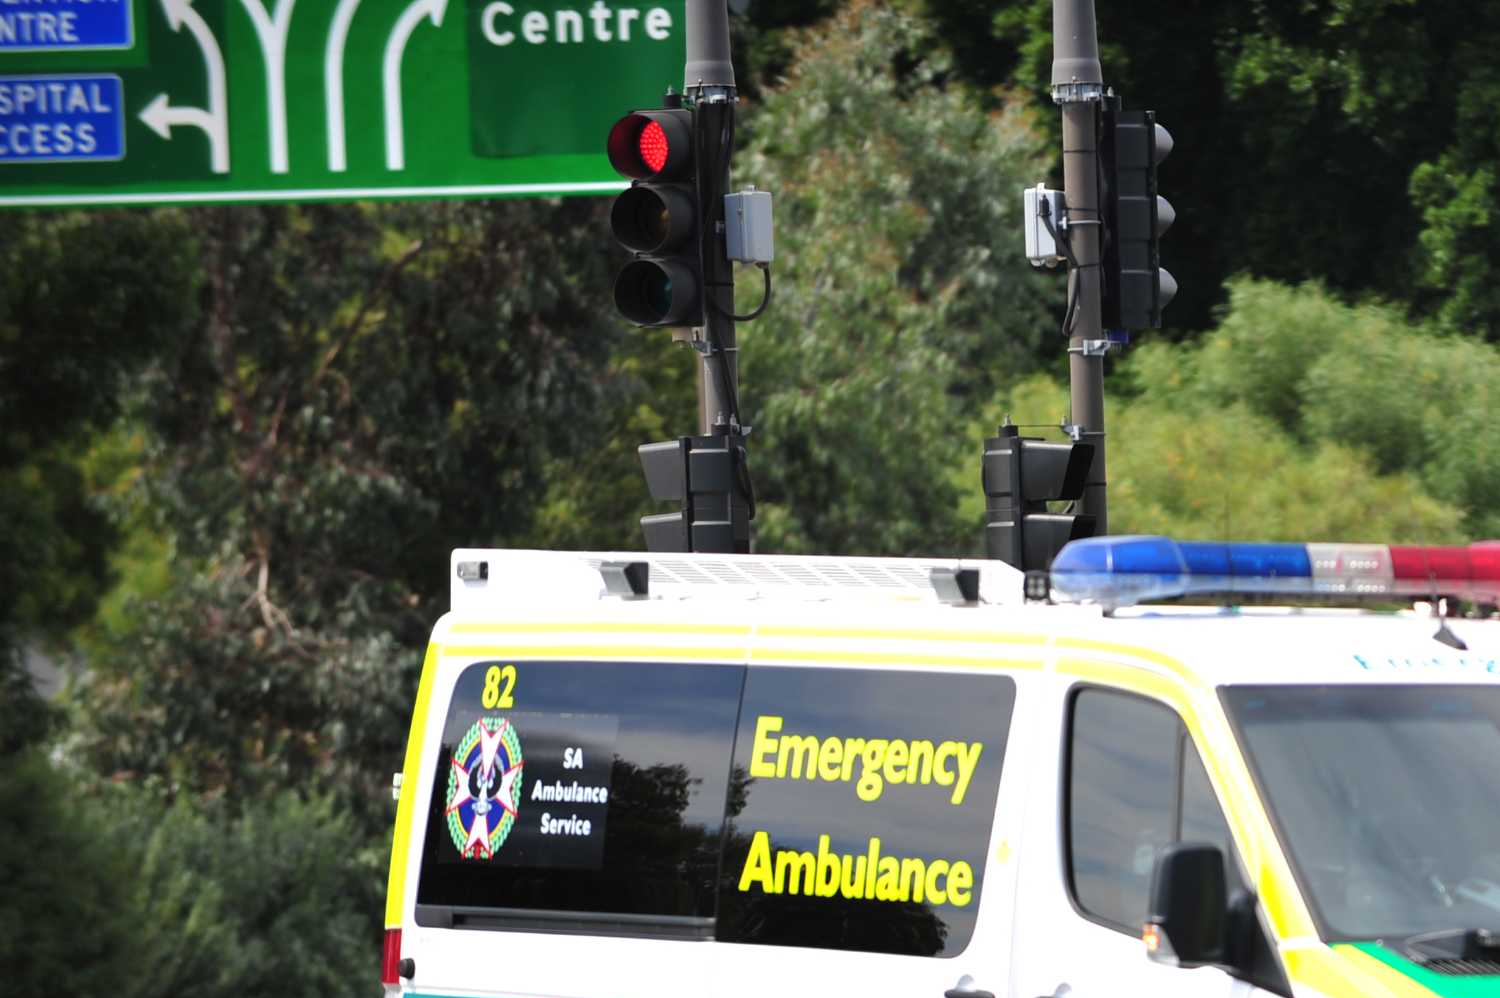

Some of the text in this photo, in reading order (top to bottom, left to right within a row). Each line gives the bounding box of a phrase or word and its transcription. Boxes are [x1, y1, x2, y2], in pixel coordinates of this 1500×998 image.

[481, 1, 672, 46] Centre
[481, 664, 517, 709] 82
[563, 748, 584, 770] SA
[750, 715, 984, 806] Emergency
[531, 779, 609, 804] Ambulance
[540, 812, 592, 836] Service
[738, 830, 975, 907] Ambulance
